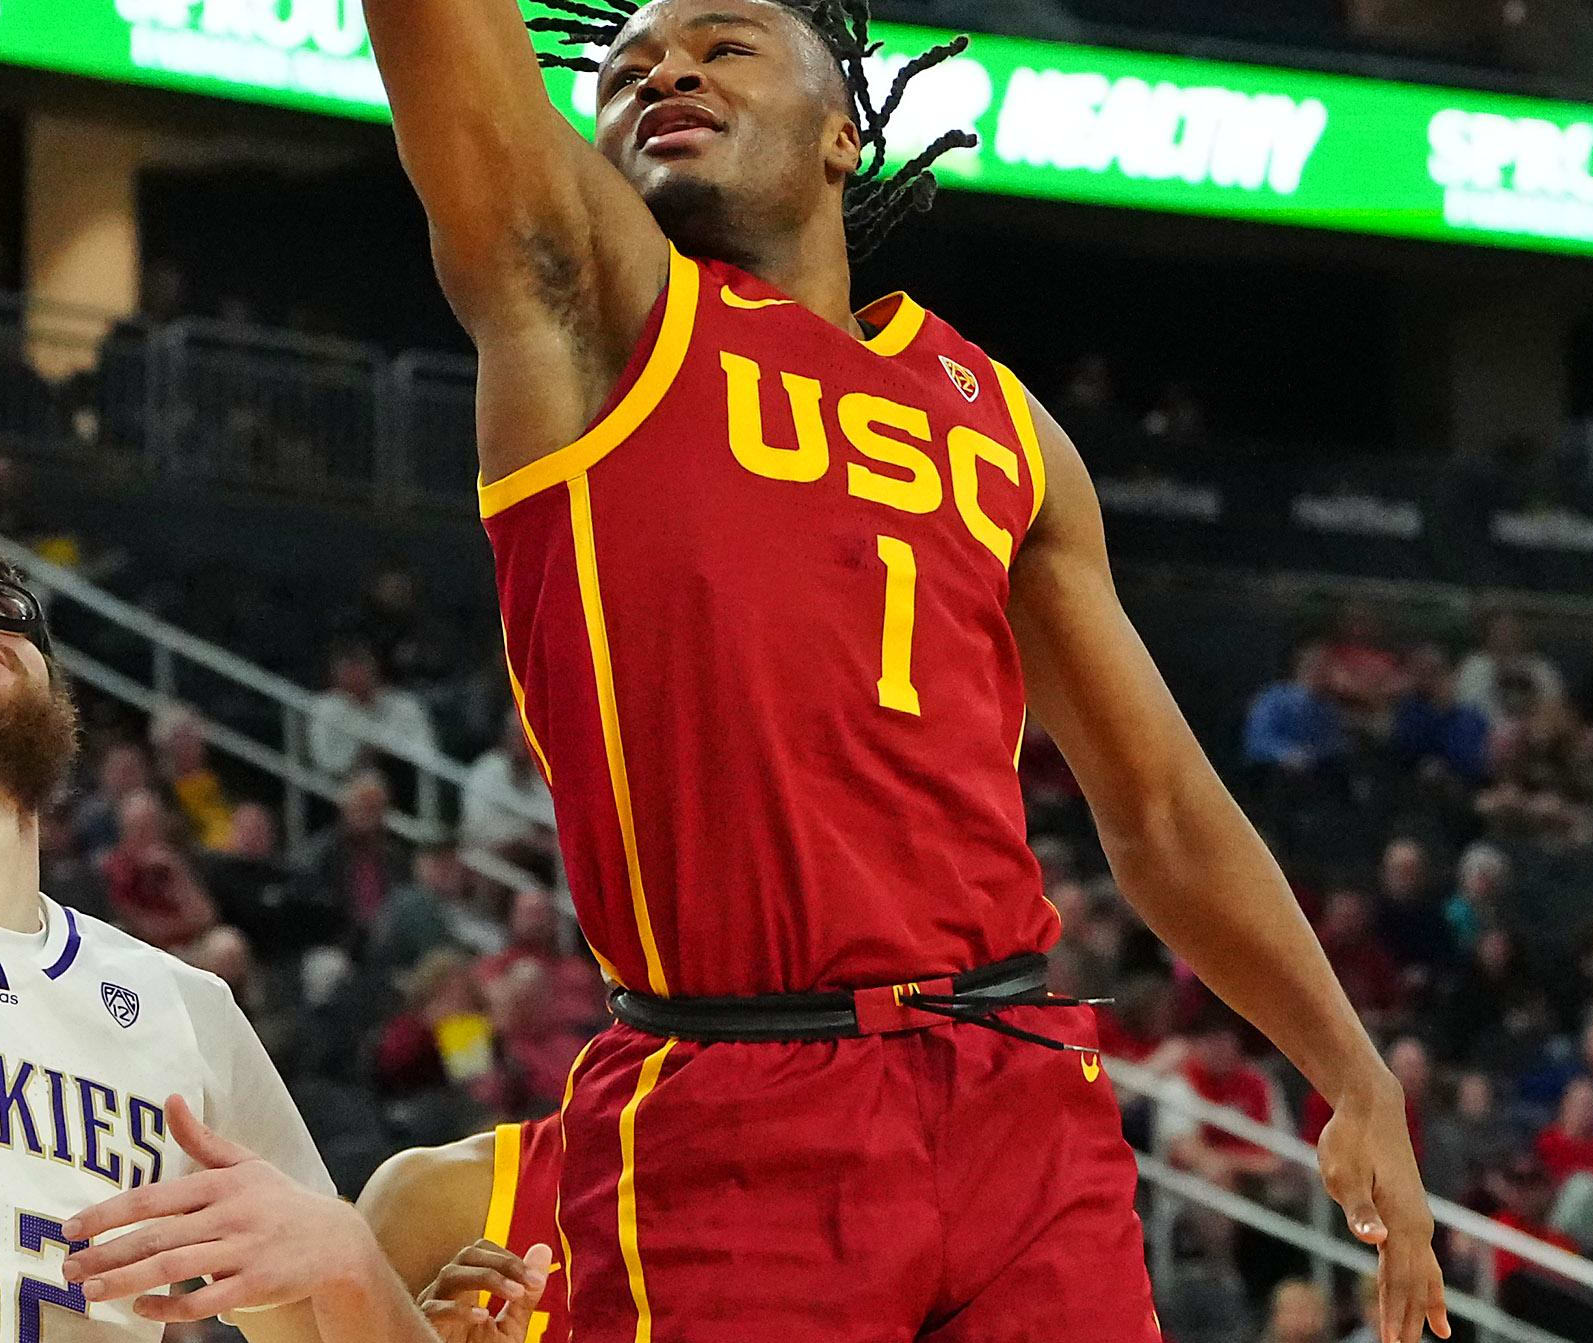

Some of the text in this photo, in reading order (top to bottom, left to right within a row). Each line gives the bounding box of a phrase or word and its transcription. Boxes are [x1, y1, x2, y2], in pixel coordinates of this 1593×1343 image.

[994, 66, 1329, 195] HEALTHY
[718, 349, 1020, 573] USC
[876, 533, 922, 717] 1
[104, 986, 136, 1015] PAC
[112, 1005, 131, 1022] 12
